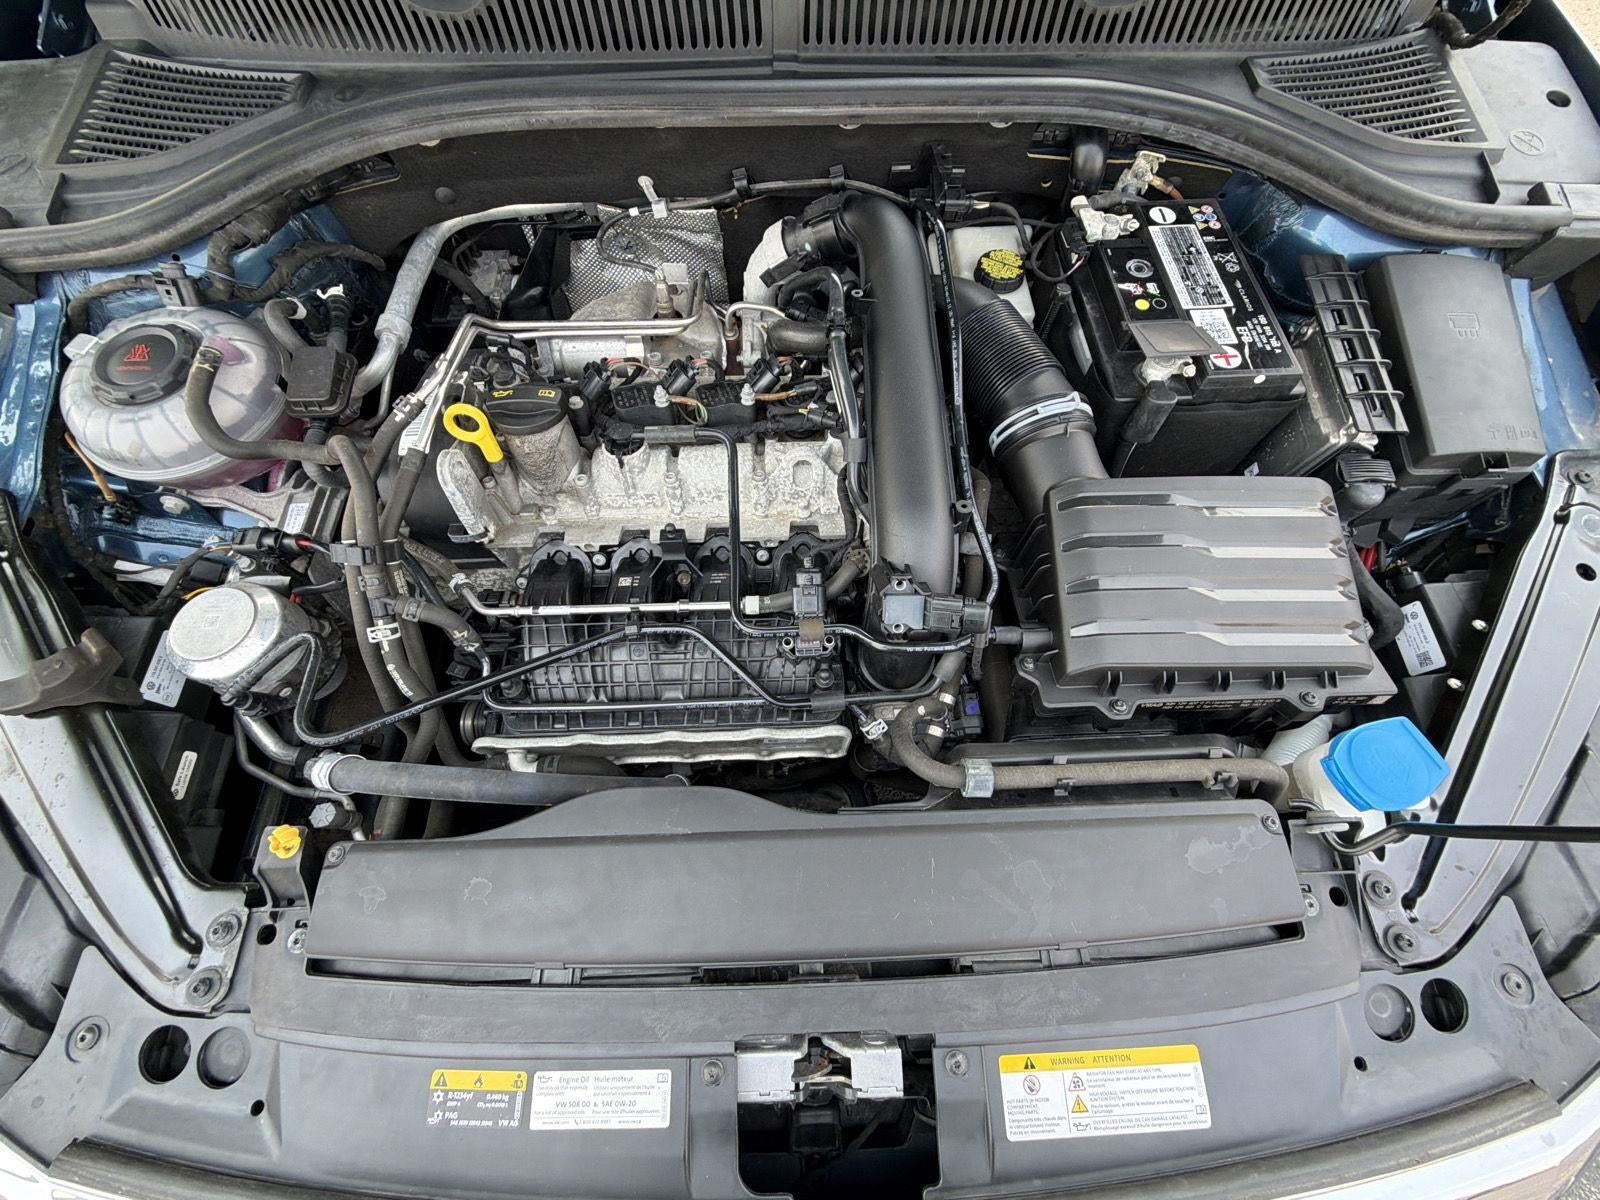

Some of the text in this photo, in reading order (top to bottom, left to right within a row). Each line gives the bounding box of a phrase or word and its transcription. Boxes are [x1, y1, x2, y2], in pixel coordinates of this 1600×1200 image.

[1050, 1054, 1131, 1066] WARNING ATTENTION
[559, 1076, 579, 1085] Engine
[448, 1092, 474, 1101] R-1234yf
